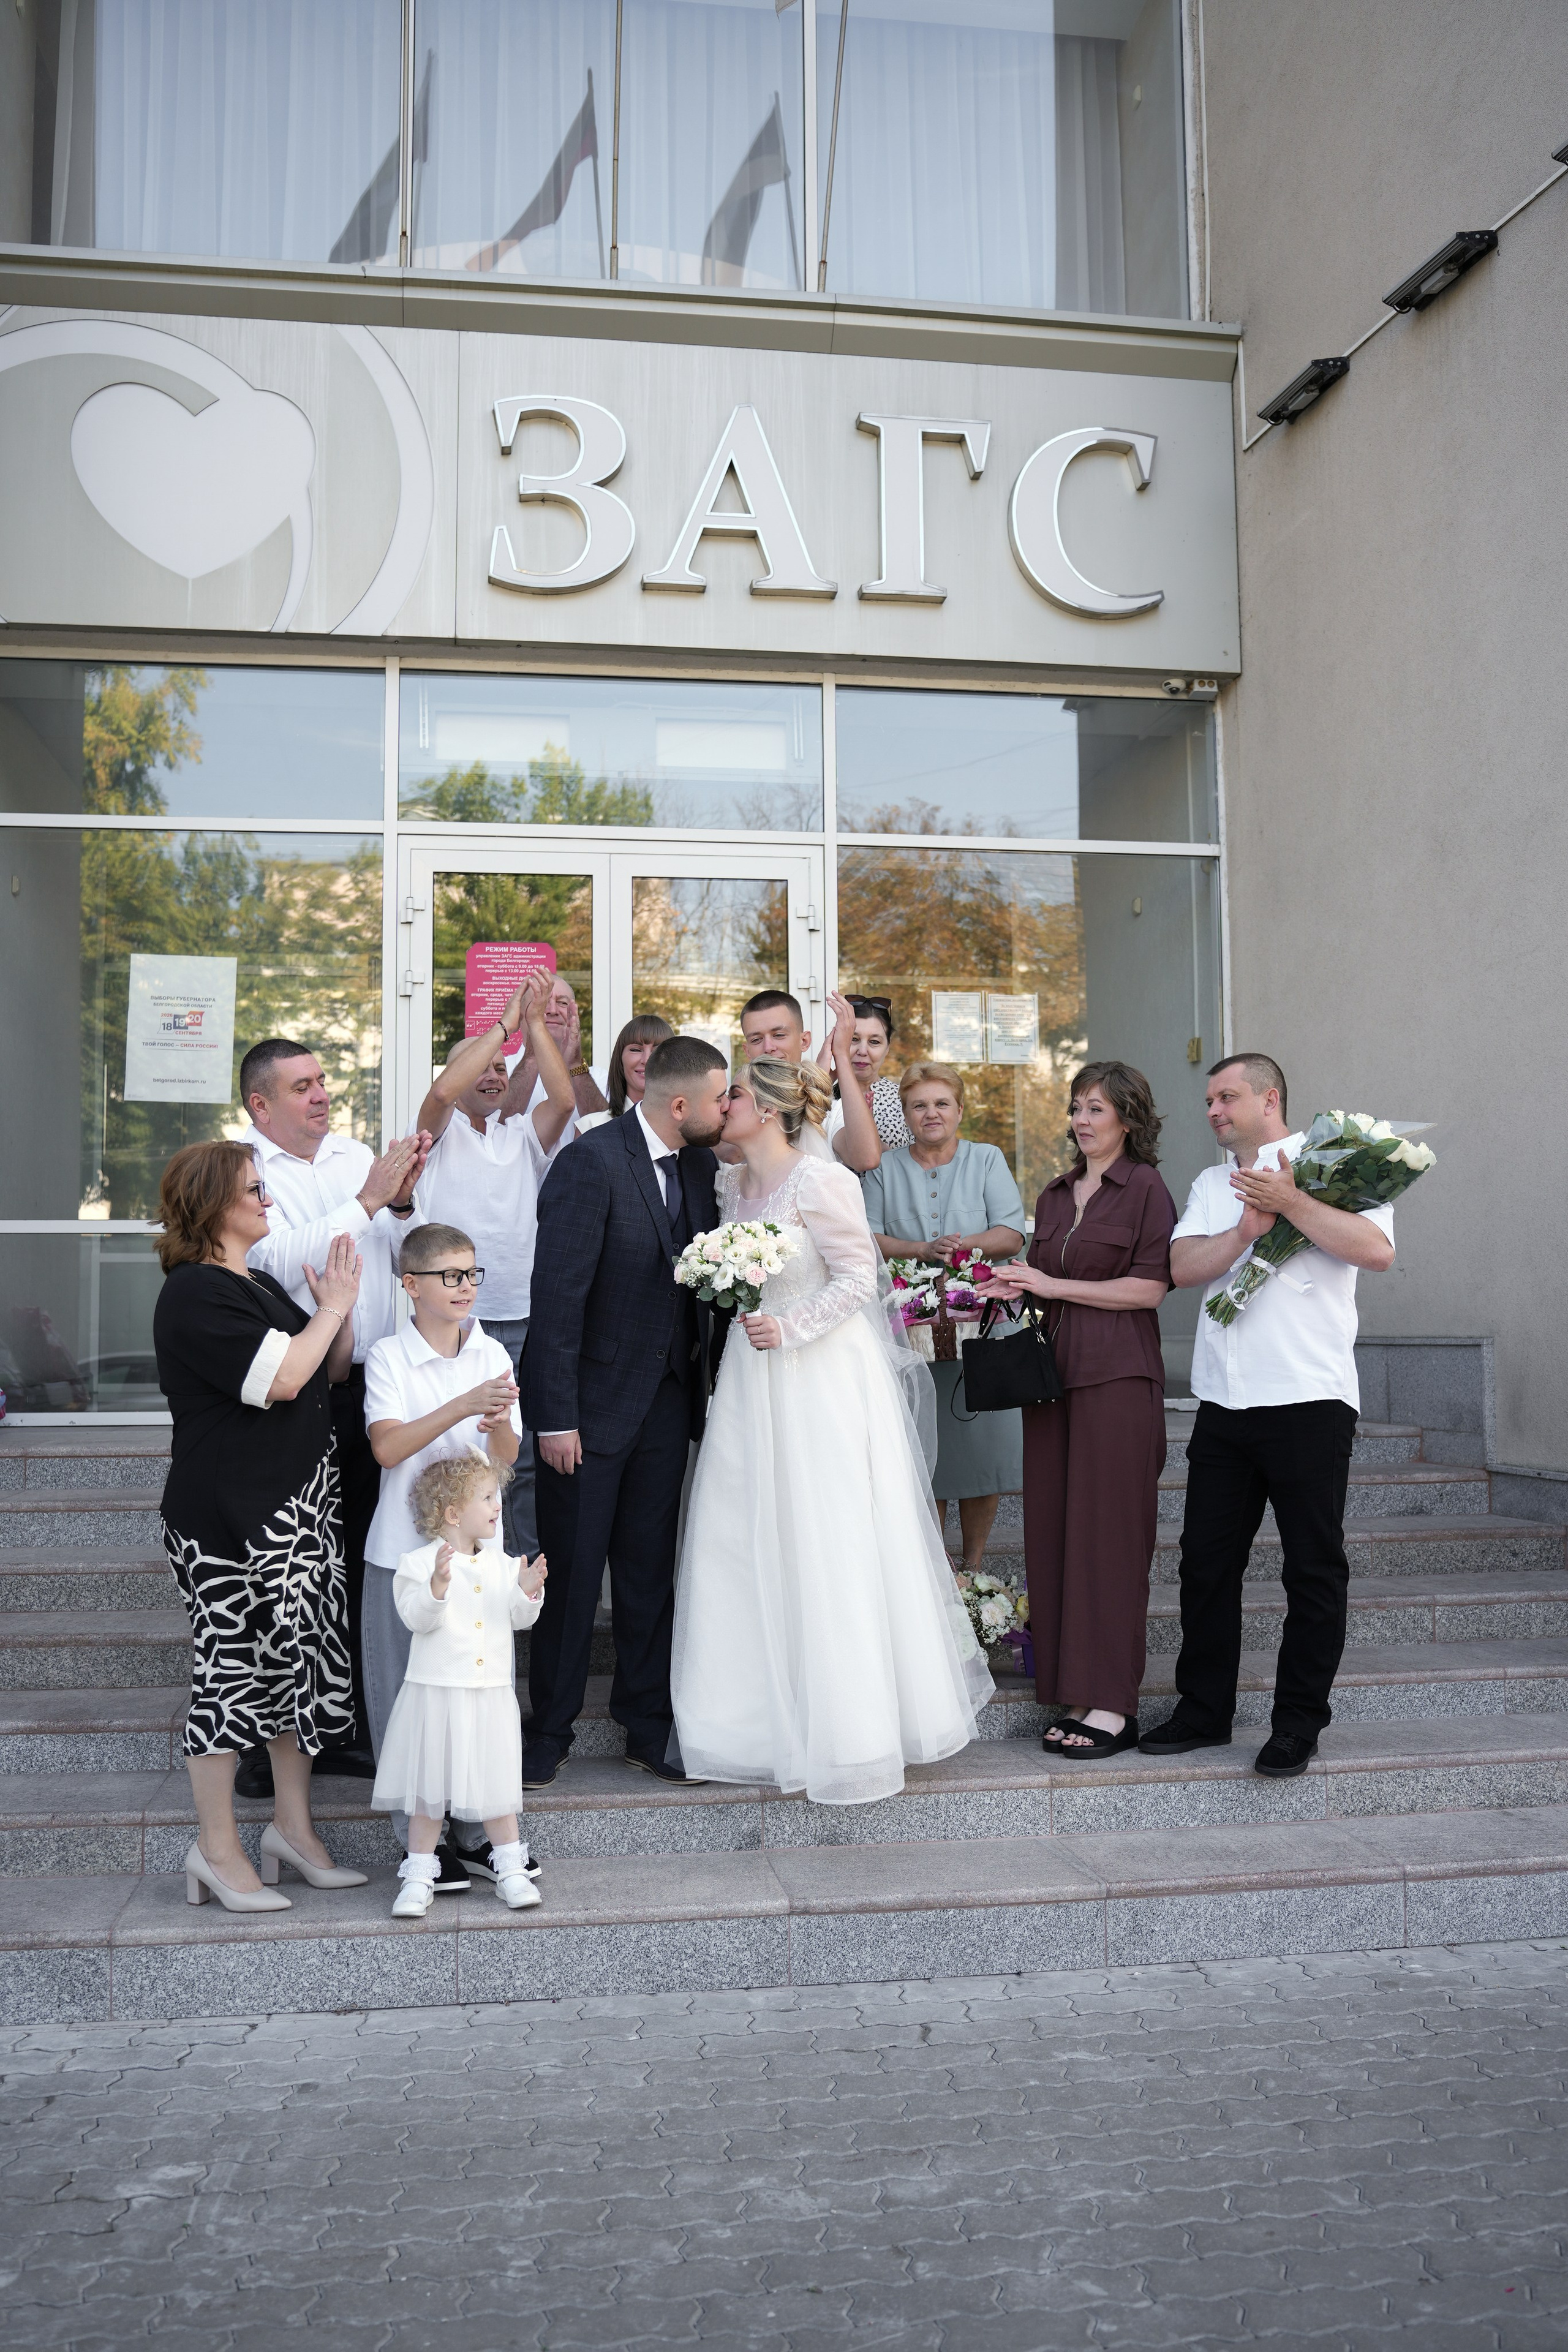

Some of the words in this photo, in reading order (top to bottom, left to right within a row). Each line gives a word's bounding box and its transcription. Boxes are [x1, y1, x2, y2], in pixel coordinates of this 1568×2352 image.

[488, 394, 1165, 620] ЗАГС
[162, 1022, 173, 1031] 18
[175, 1017, 186, 1027] 19
[188, 1014, 202, 1023] 20
